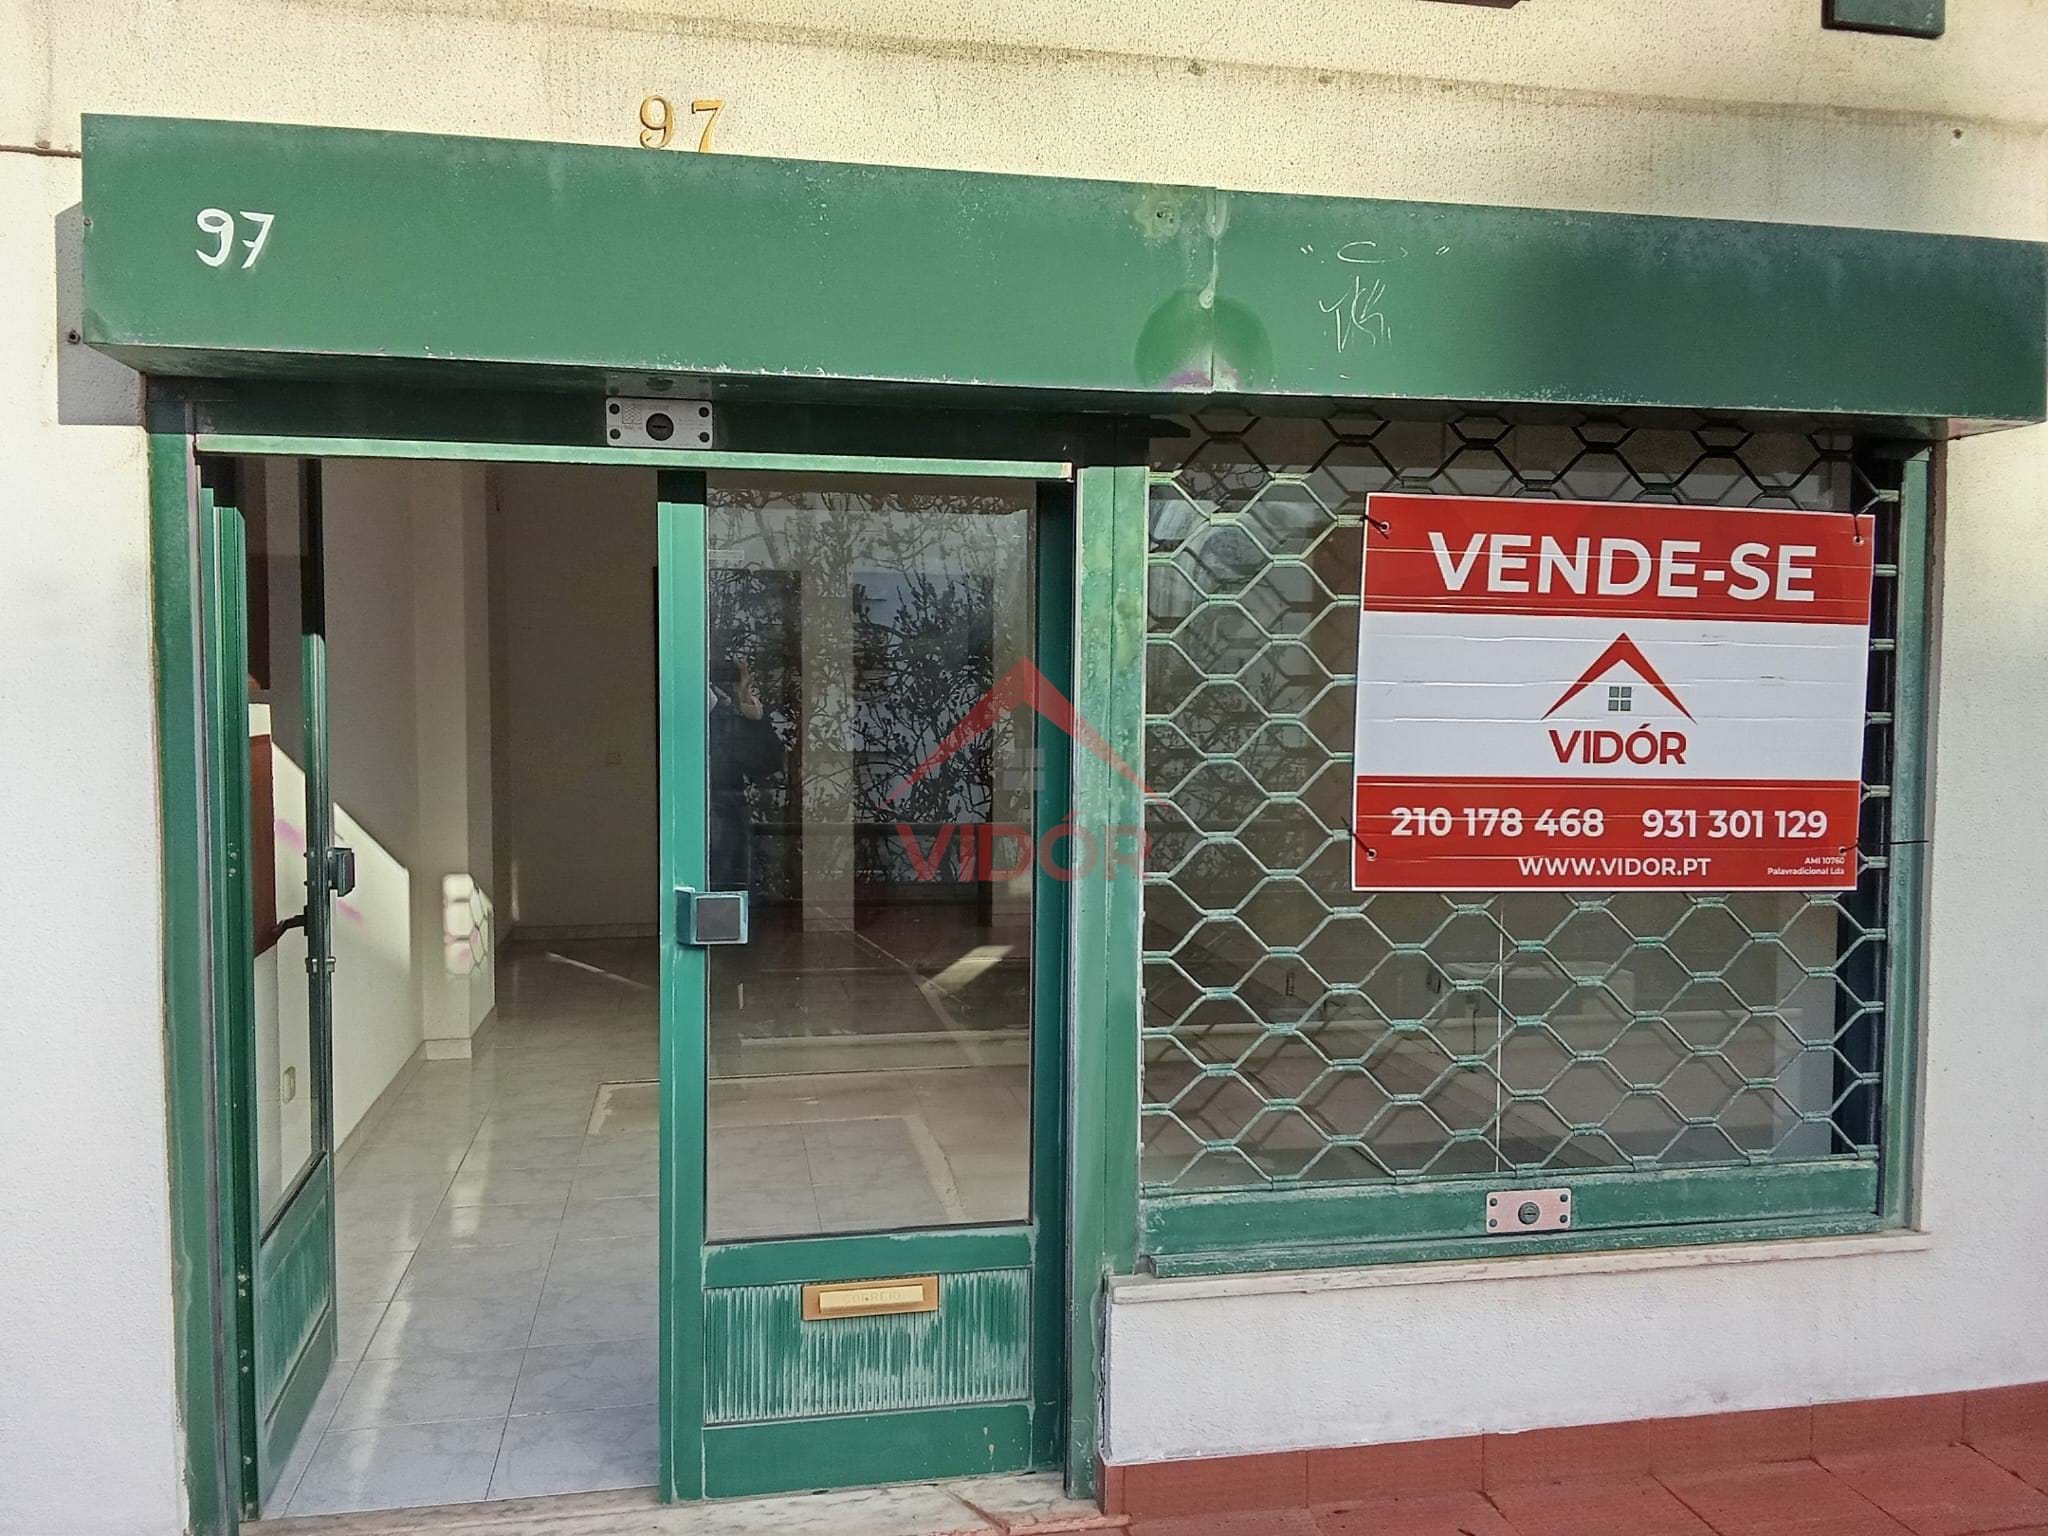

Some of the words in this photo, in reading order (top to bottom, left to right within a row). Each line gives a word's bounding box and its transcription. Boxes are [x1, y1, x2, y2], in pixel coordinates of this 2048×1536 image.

[639, 95, 725, 153] 97
[195, 208, 275, 269] 97
[1427, 531, 1817, 603] VENDE-SE
[1548, 723, 1687, 766] VIDÓR
[1390, 807, 1452, 837] 210
[1463, 807, 1523, 838] 178
[1534, 808, 1605, 838] 468
[1641, 808, 1697, 839] 931
[1707, 809, 1764, 839] 301
[1774, 810, 1828, 839] 129
[1517, 856, 1712, 877] WWW.VIDOR.PT
[1767, 867, 1829, 876] Palavradicional
[1830, 867, 1845, 876] Lda
[1804, 856, 1821, 865] AMI
